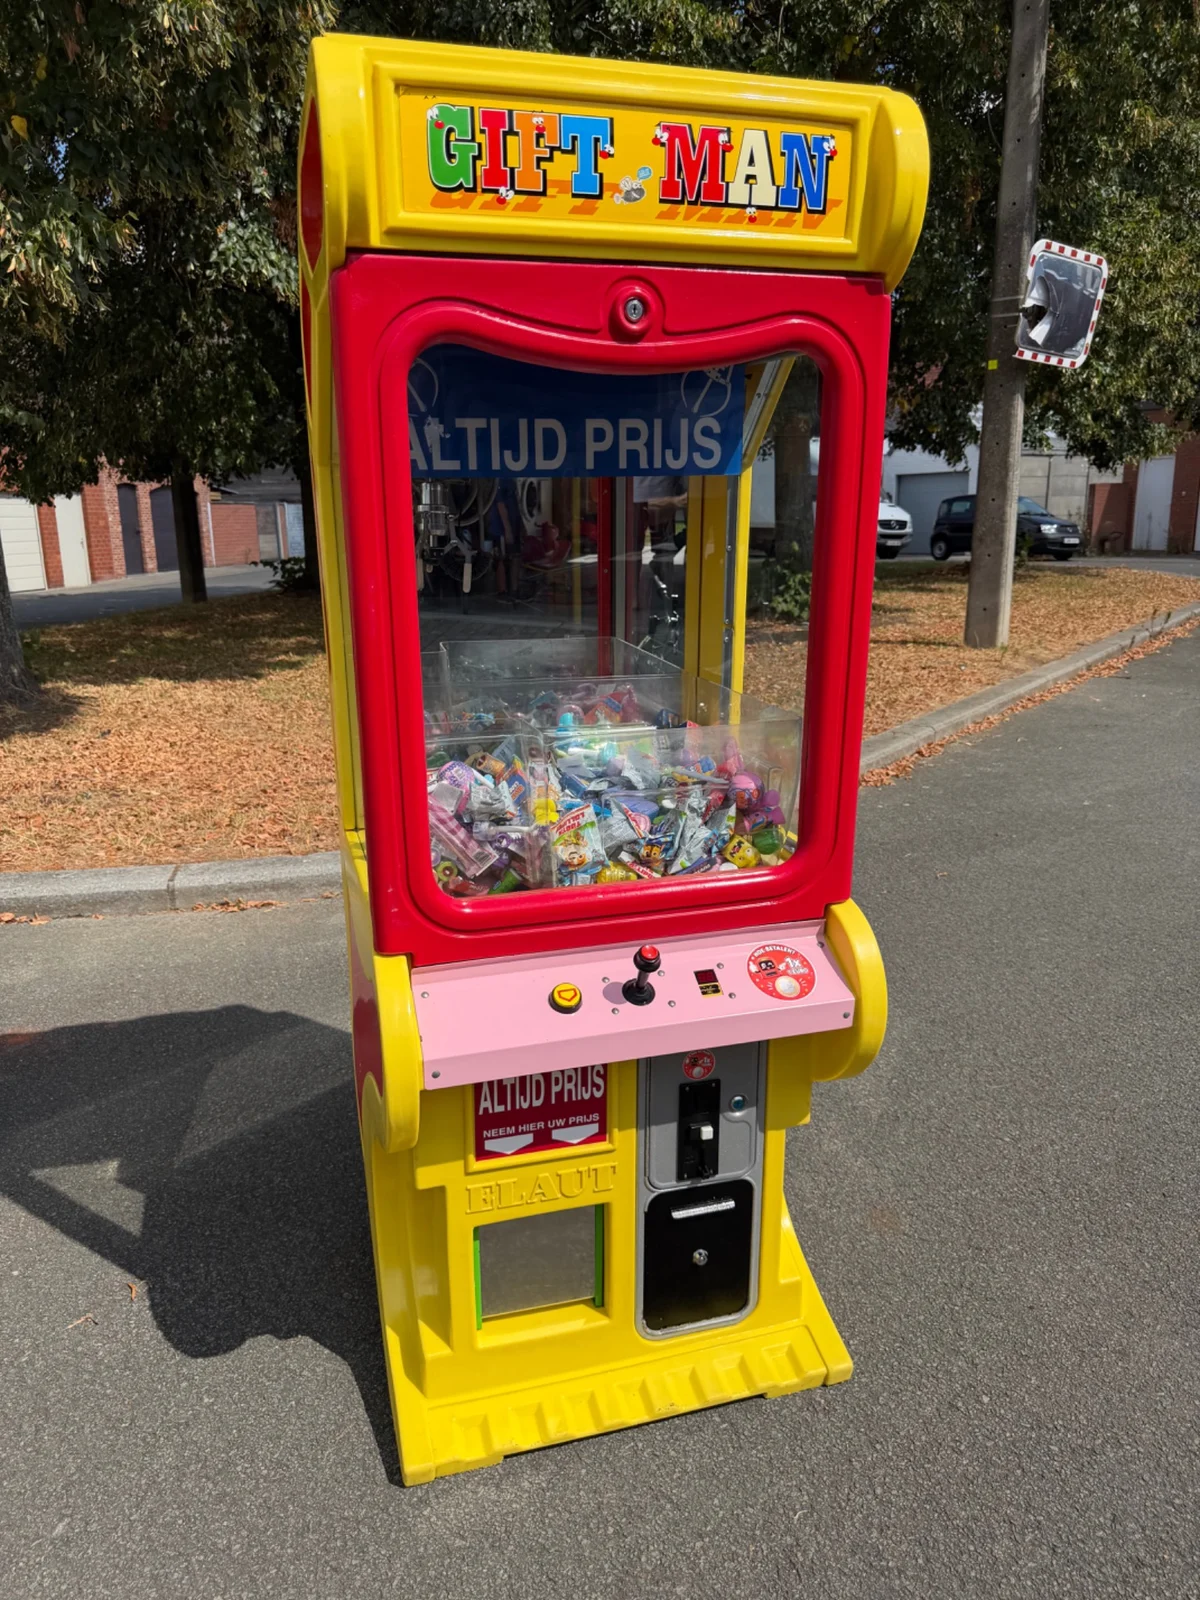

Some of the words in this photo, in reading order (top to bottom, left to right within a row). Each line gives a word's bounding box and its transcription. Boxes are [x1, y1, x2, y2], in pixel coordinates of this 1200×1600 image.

[427, 103, 613, 197] GIFT
[658, 121, 834, 213] MAN
[585, 416, 722, 470] PRIJS
[479, 1073, 545, 1115] ALTIJD
[551, 1064, 605, 1104] PRIJS
[483, 1126, 515, 1138] NEEM
[518, 1121, 545, 1133] HIER
[547, 1118, 566, 1128] UW
[568, 1113, 600, 1125] PRIJS
[465, 1163, 618, 1214] ELAUT
